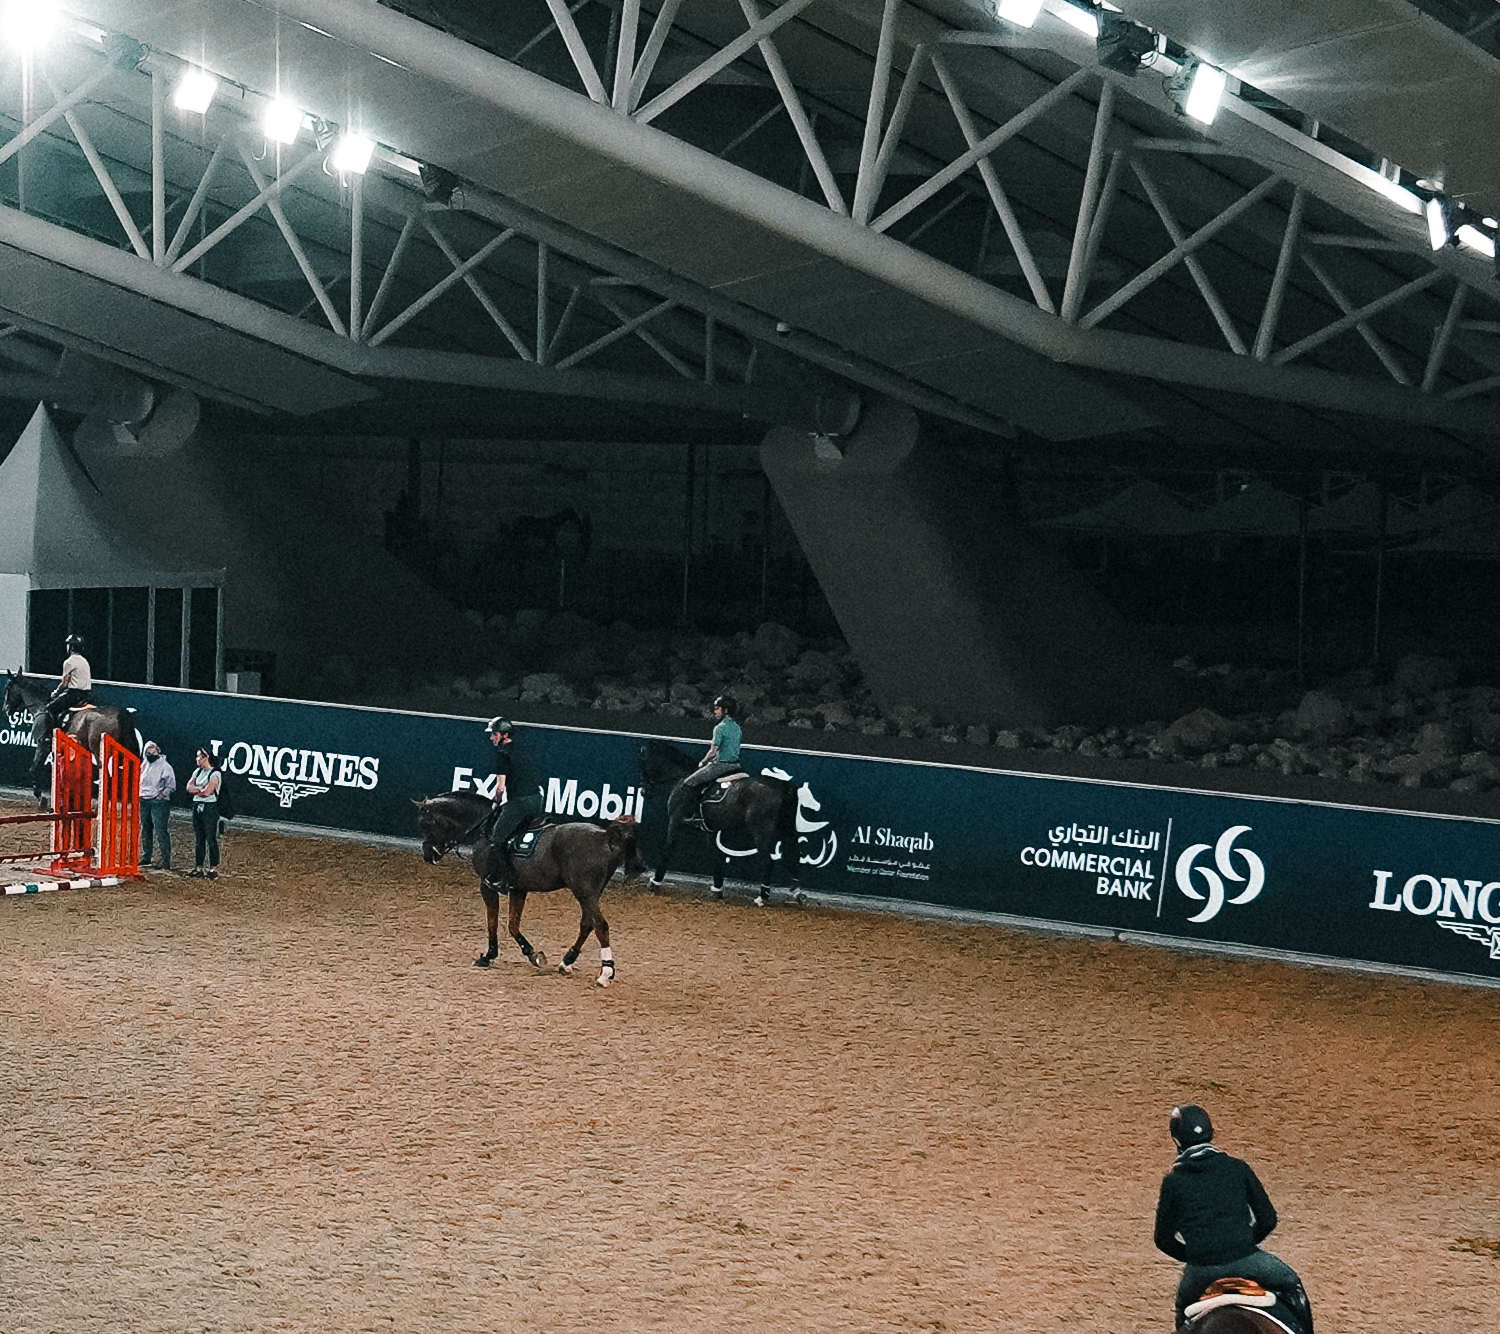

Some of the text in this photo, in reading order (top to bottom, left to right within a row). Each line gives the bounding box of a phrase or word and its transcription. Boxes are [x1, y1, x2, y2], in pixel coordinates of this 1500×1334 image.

[851, 825, 934, 854] Al Shaqab
[1048, 822, 1160, 854] البنك التجاري
[1020, 846, 1155, 880] COMMERCIAL
[1096, 876, 1153, 900] BANK
